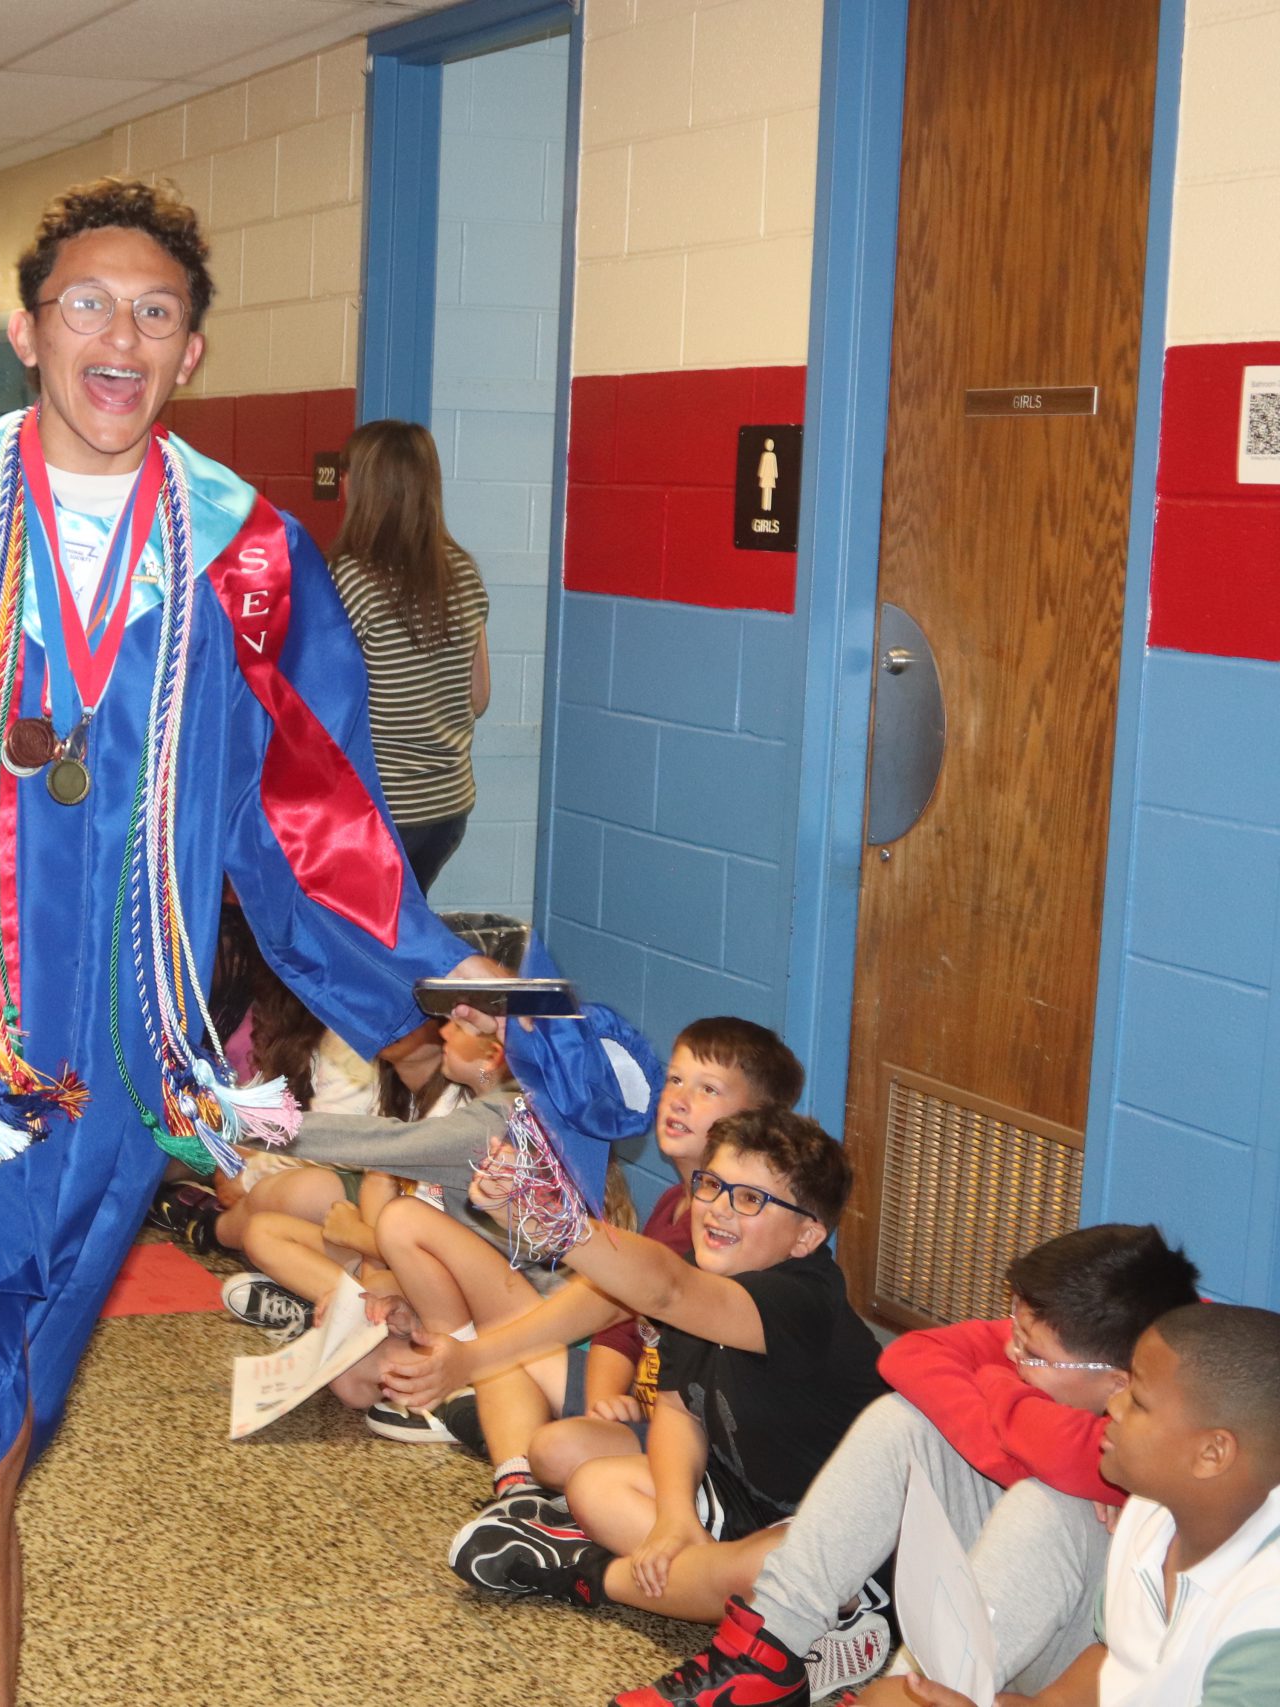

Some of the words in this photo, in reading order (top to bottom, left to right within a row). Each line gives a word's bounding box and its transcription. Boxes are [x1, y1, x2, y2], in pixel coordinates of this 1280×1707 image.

[1013, 395, 1042, 409] GIRLS
[318, 466, 336, 486] 222
[751, 518, 780, 534] GIRLS
